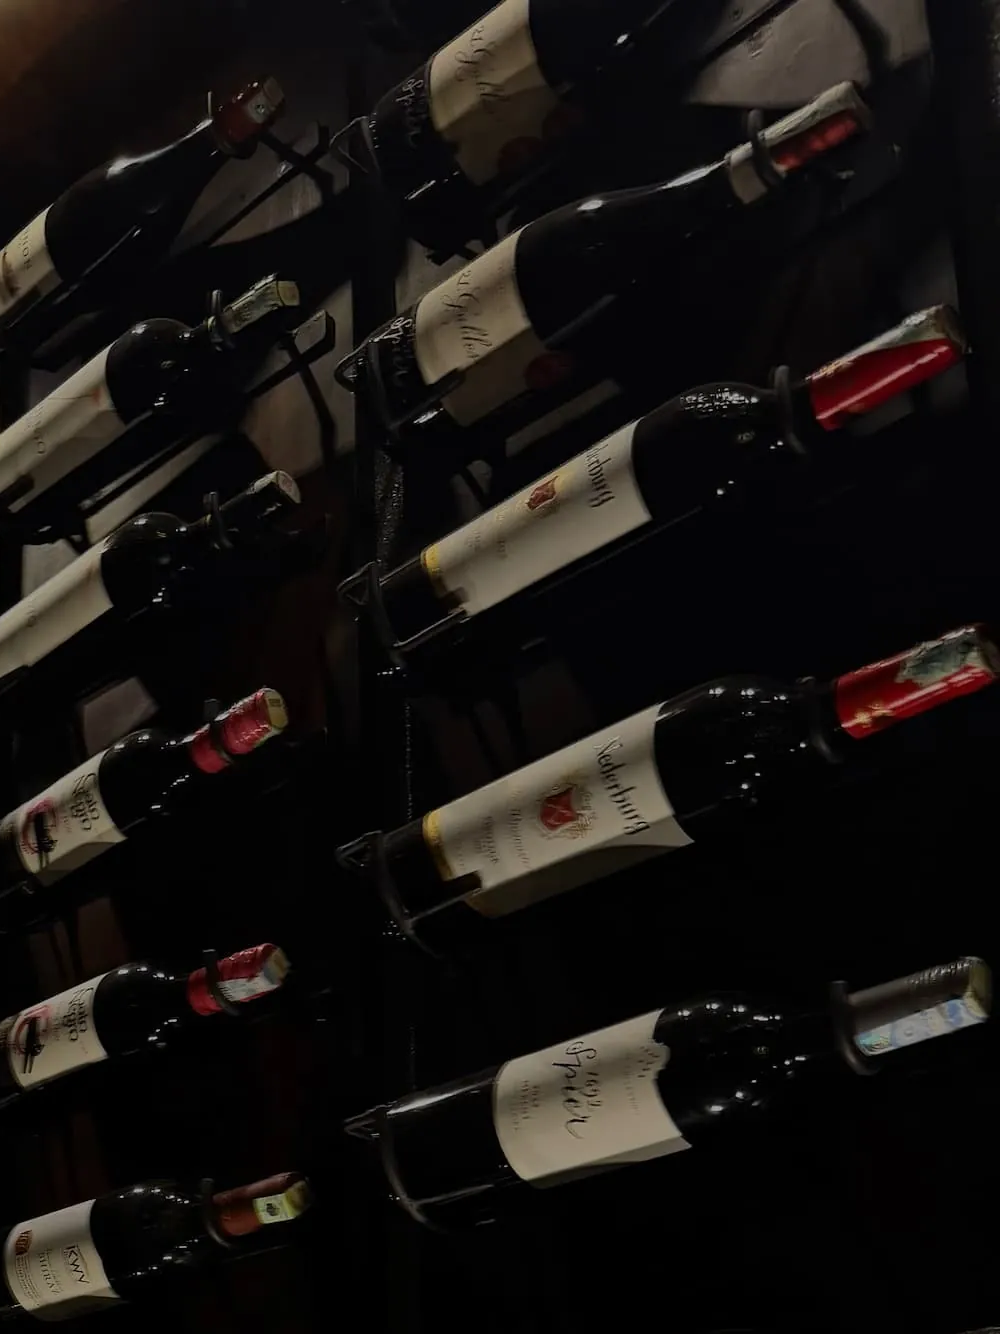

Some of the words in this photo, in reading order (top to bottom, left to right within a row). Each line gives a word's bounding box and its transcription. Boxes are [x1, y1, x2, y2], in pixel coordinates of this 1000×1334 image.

[593, 733, 654, 838] Nederburg
[550, 1039, 598, 1140] Spier
[64, 1243, 91, 1285] KWV
